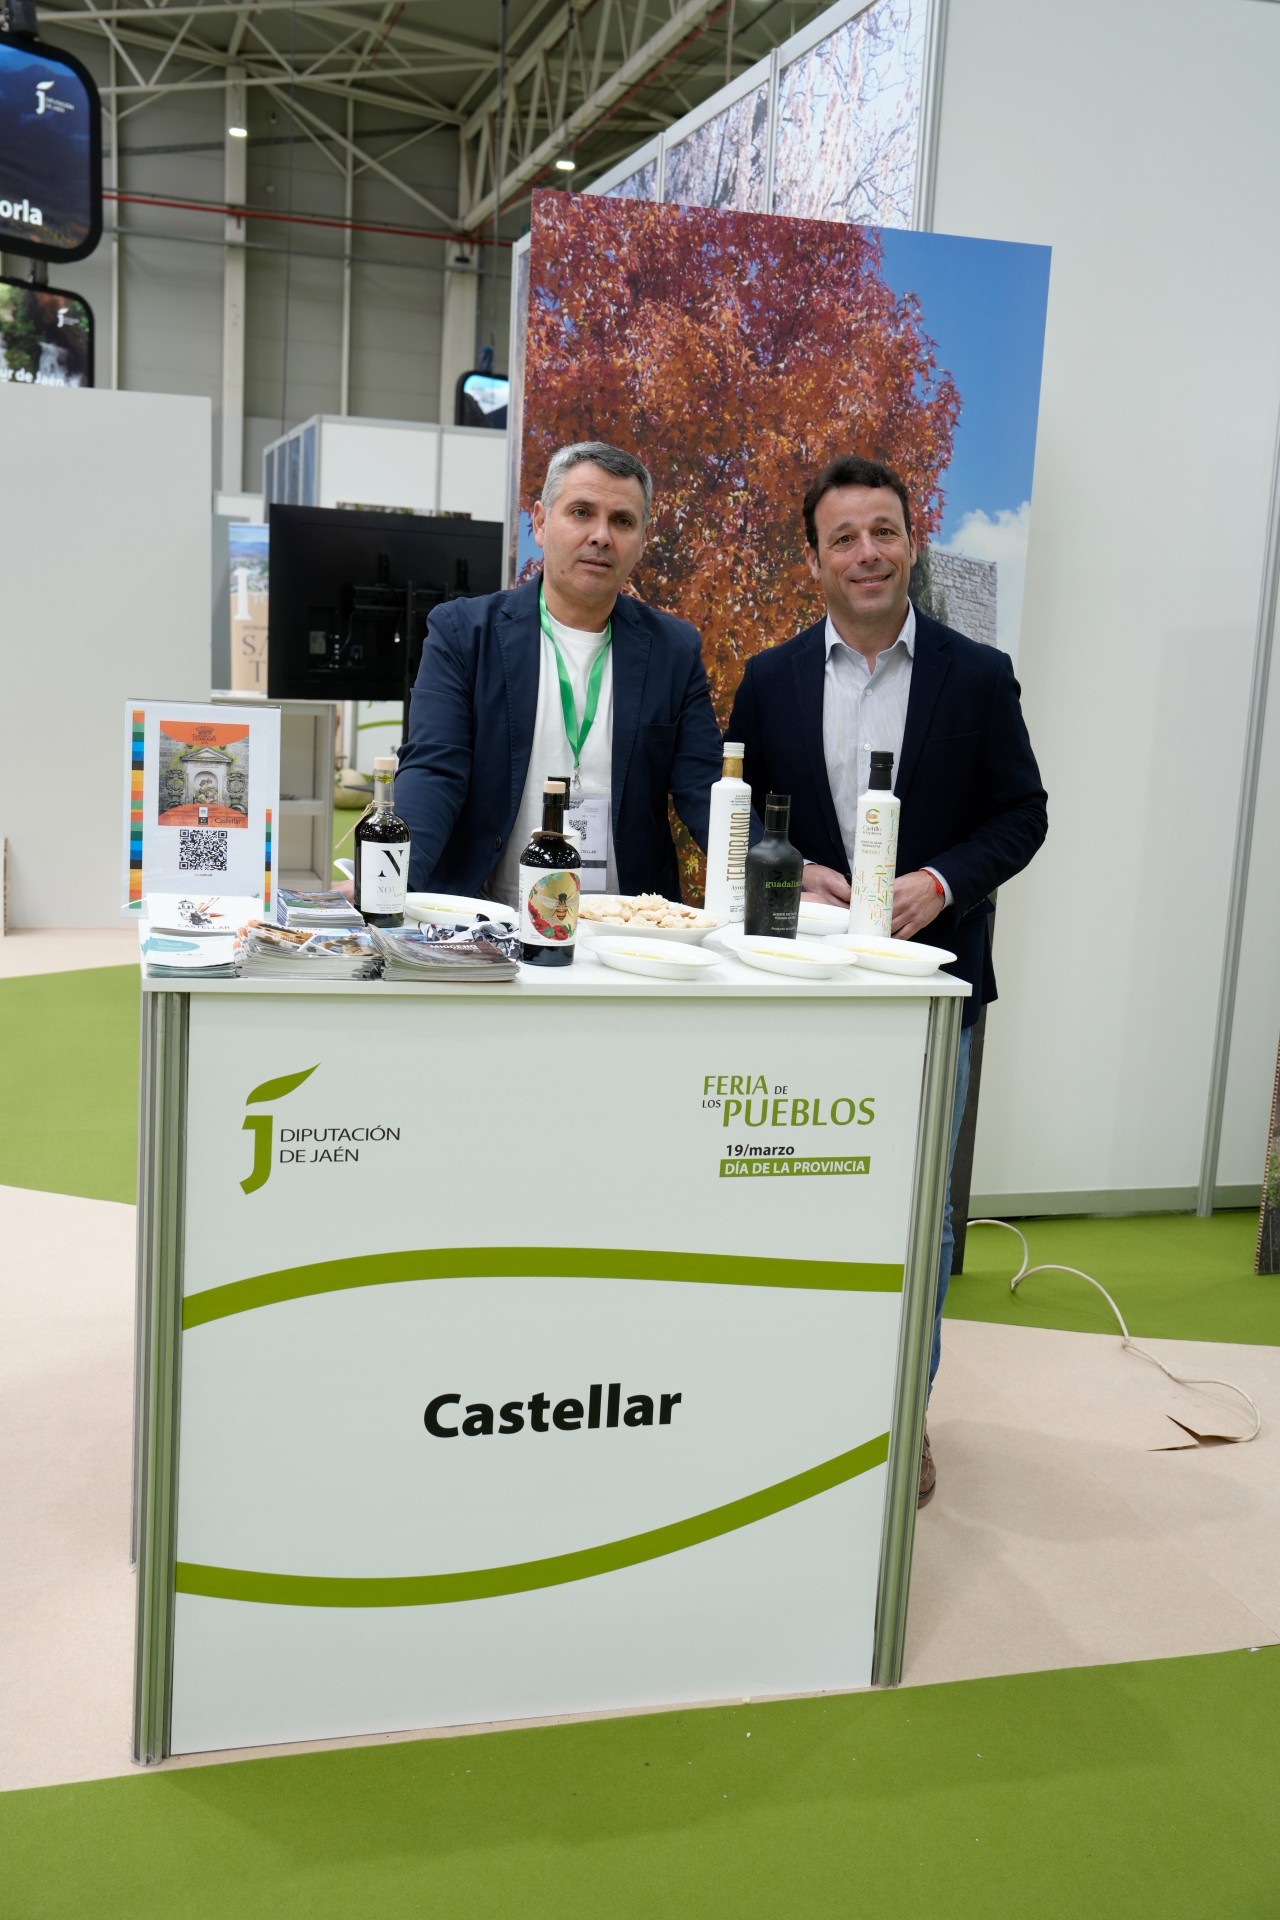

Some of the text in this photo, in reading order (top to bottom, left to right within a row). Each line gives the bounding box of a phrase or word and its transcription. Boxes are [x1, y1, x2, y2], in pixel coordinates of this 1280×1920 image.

[15, 367, 33, 383] de
[214, 817, 242, 825] Castellar
[177, 922, 231, 930] CASTELLAR
[703, 1075, 788, 1095] FERIA DE
[702, 1097, 876, 1127] LOS PUEBLOS
[280, 1125, 401, 1142] DIPUTACIÓN
[279, 1146, 359, 1163] DE JAÉN
[726, 1143, 795, 1157] 19/marzo
[724, 1160, 866, 1175] DÍA DE LA PROVINCIA
[423, 1383, 682, 1438] Castellar
